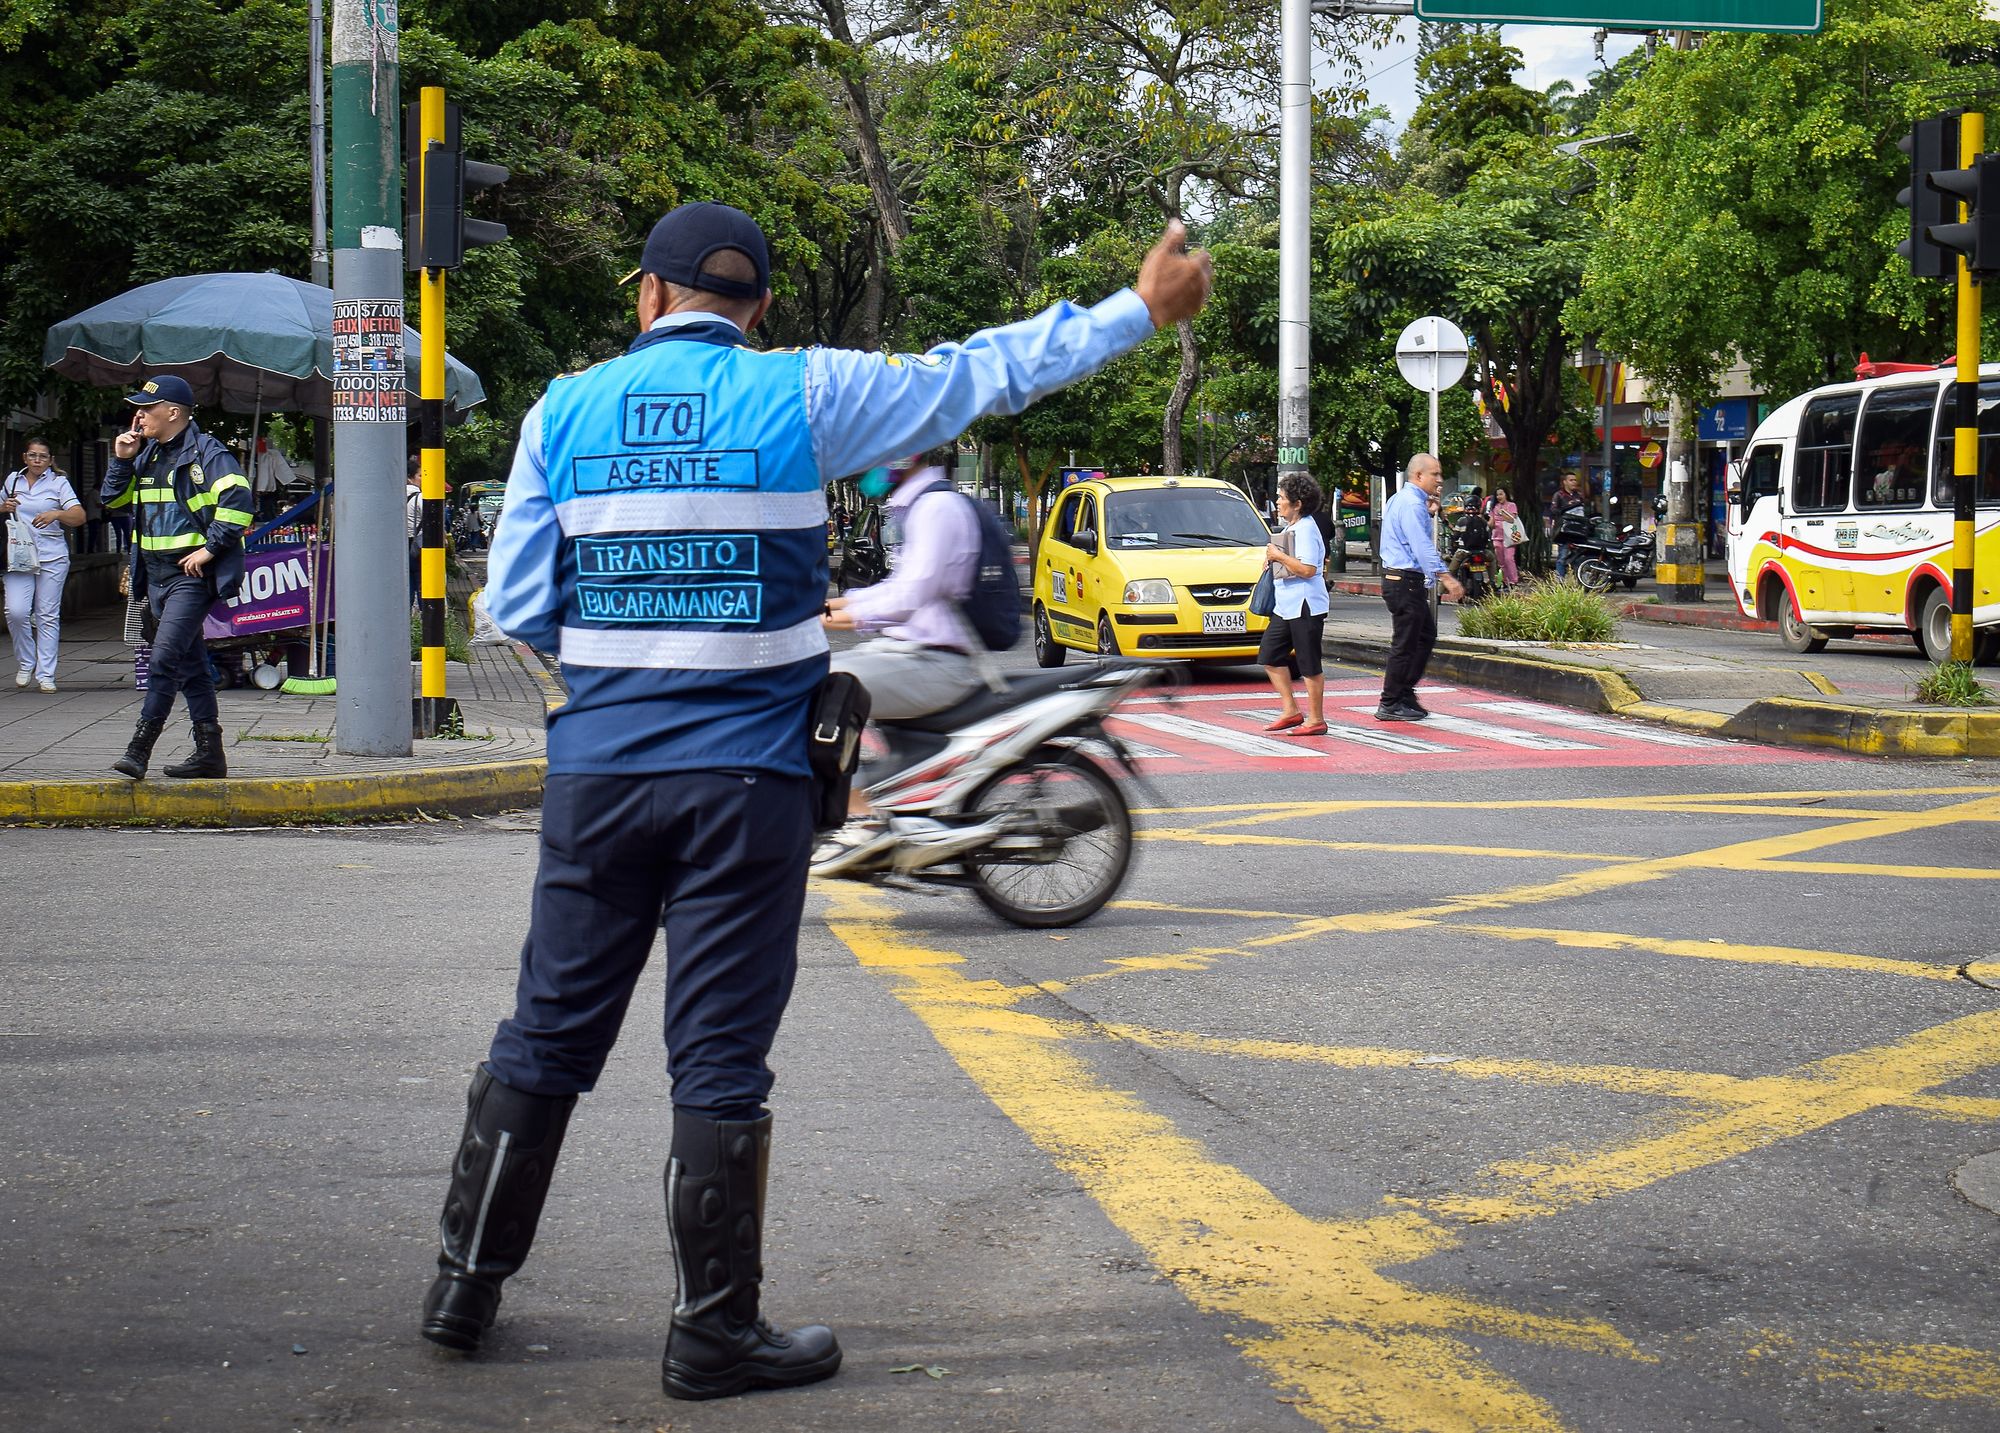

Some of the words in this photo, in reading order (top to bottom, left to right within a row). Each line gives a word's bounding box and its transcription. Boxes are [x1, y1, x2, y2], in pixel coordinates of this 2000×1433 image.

[368, 333, 381, 347] 318
[356, 406, 376, 421] 450
[380, 406, 398, 421] 318
[634, 401, 693, 437] 170
[606, 457, 721, 487] AGENTE
[591, 540, 738, 571] TRANSITO
[585, 589, 751, 618] BUCARAMANGA
